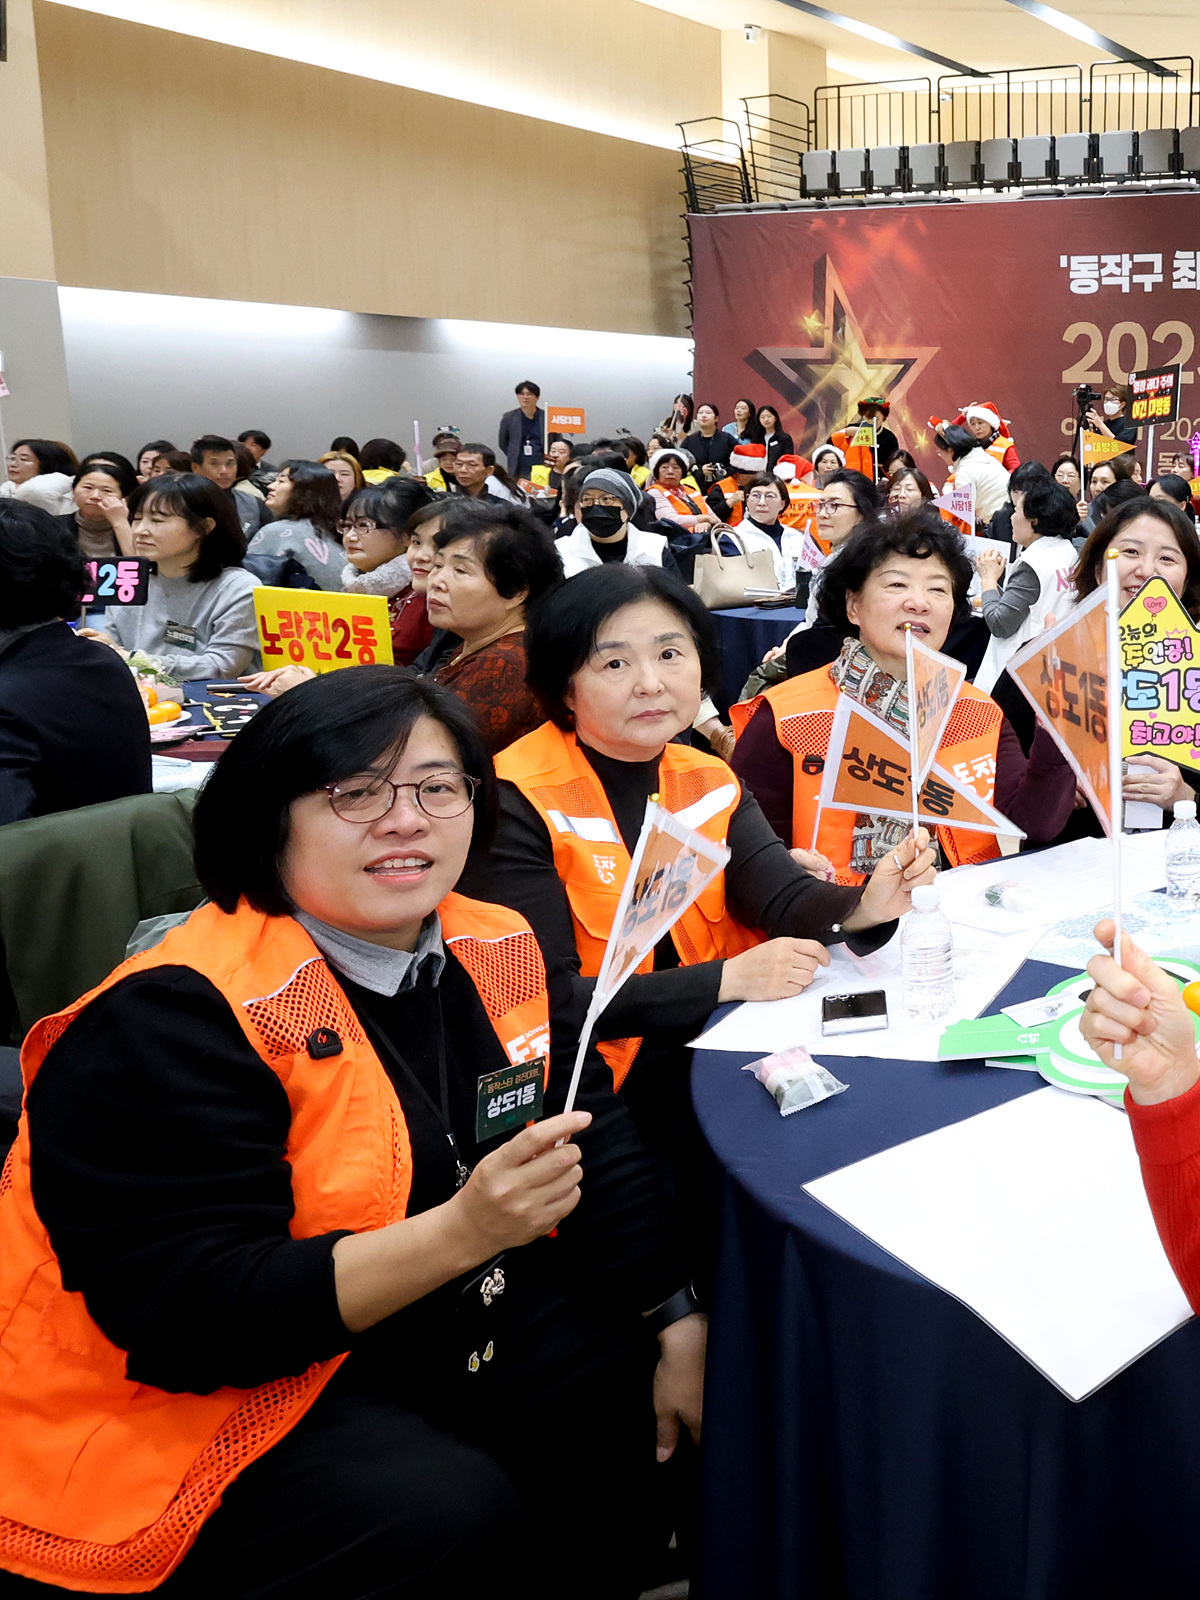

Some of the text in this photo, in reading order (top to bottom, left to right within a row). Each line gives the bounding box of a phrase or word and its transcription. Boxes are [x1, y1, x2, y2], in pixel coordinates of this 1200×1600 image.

[1092, 441, 1120, 453] 대방동
[81, 560, 140, 603] 2동
[260, 610, 378, 666] 노량진2동
[1122, 636, 1194, 668] 주인공!
[842, 746, 955, 816] 상도동
[486, 1082, 537, 1119] 상도1동
